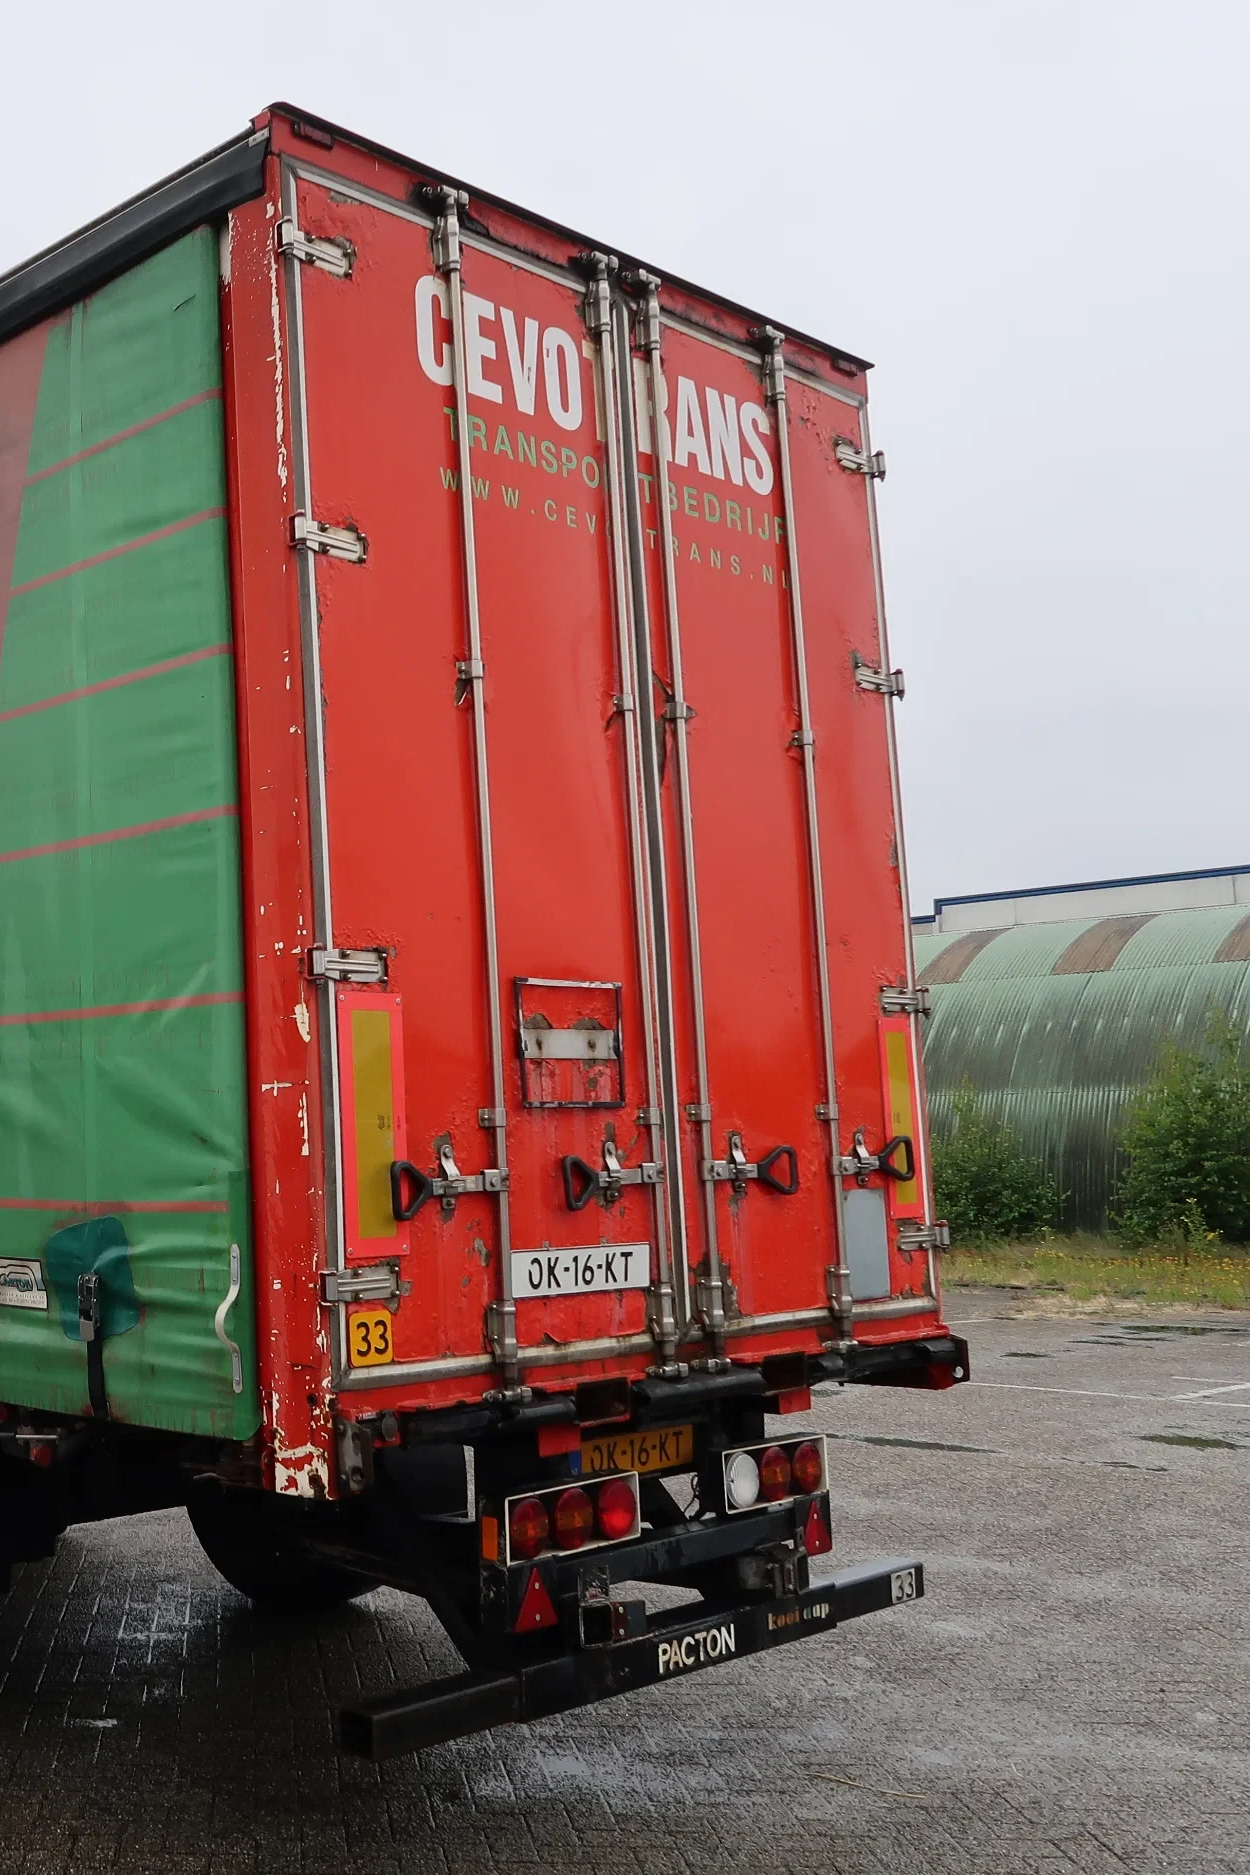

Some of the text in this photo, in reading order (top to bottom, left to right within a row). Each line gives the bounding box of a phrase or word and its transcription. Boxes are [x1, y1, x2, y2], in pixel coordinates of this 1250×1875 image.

[528, 1251, 633, 1290] OK-16-KT
[356, 1319, 389, 1357] 33
[590, 1430, 683, 1473] OK-16-KT
[894, 1571, 914, 1601] 33
[658, 1623, 735, 1674] PACTON
